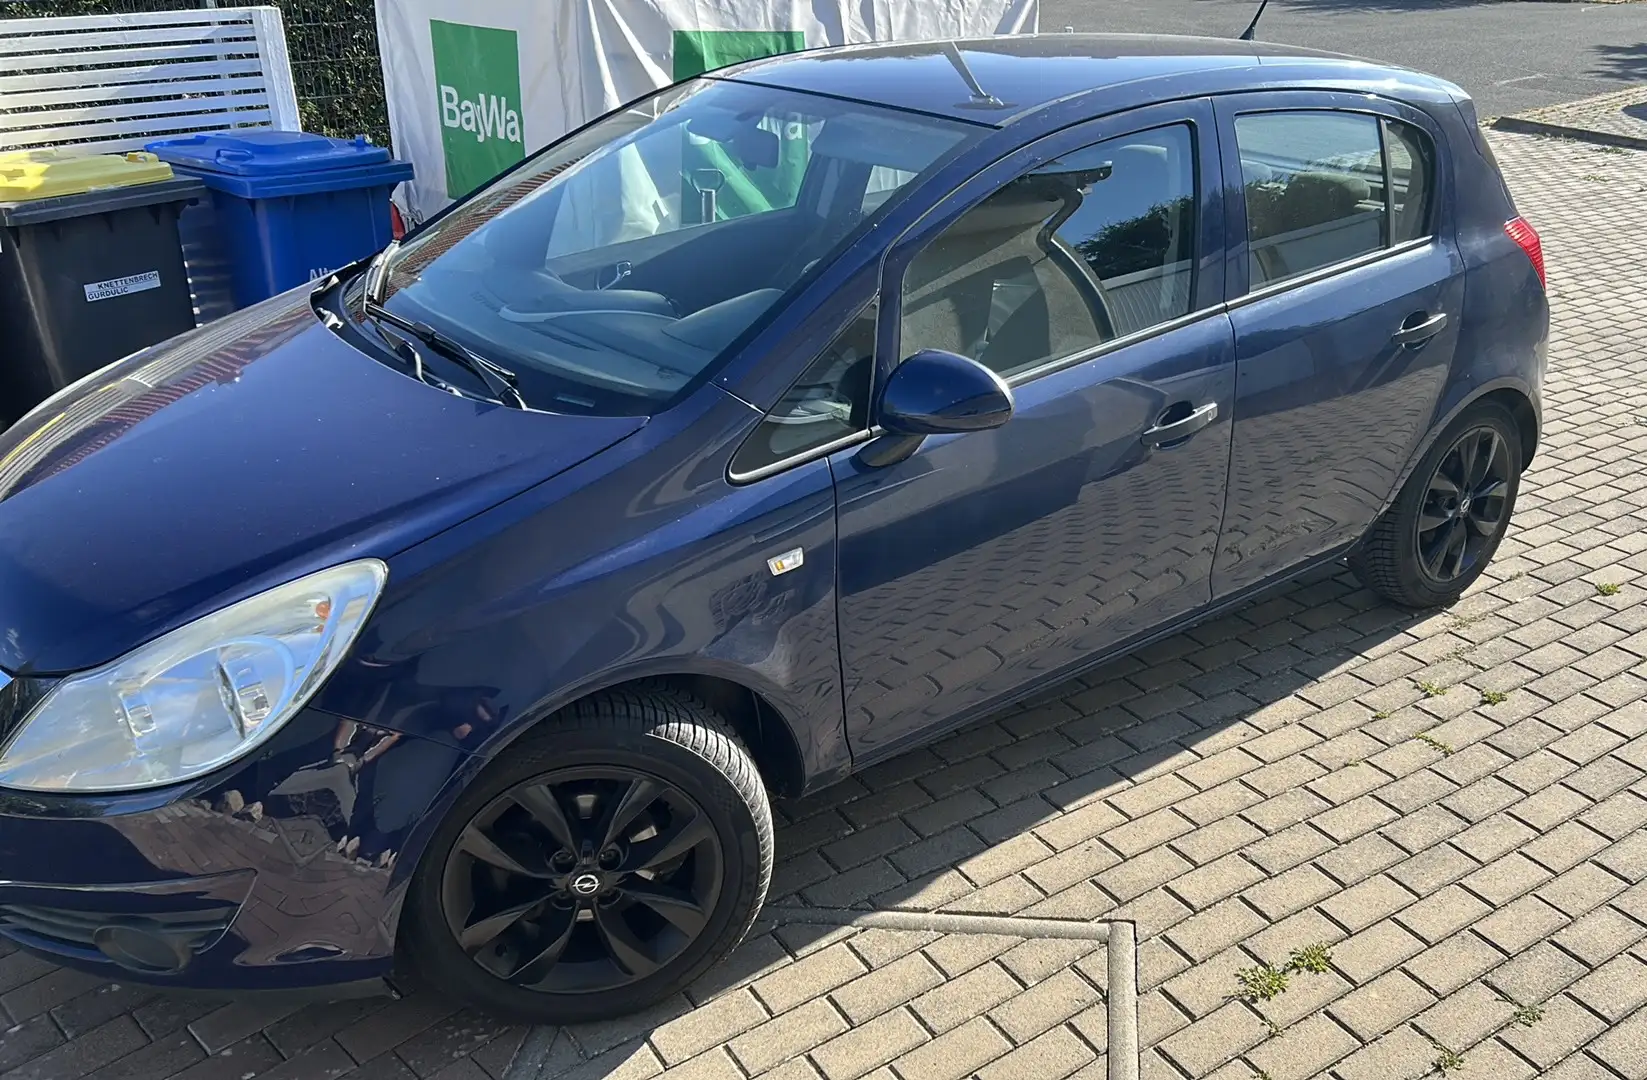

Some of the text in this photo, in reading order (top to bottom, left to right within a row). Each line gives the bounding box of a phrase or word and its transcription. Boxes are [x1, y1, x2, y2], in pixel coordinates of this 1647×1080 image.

[441, 84, 521, 143] BayWa
[97, 272, 158, 290] KNETTENBRECH
[88, 286, 129, 300] GURDULIC
